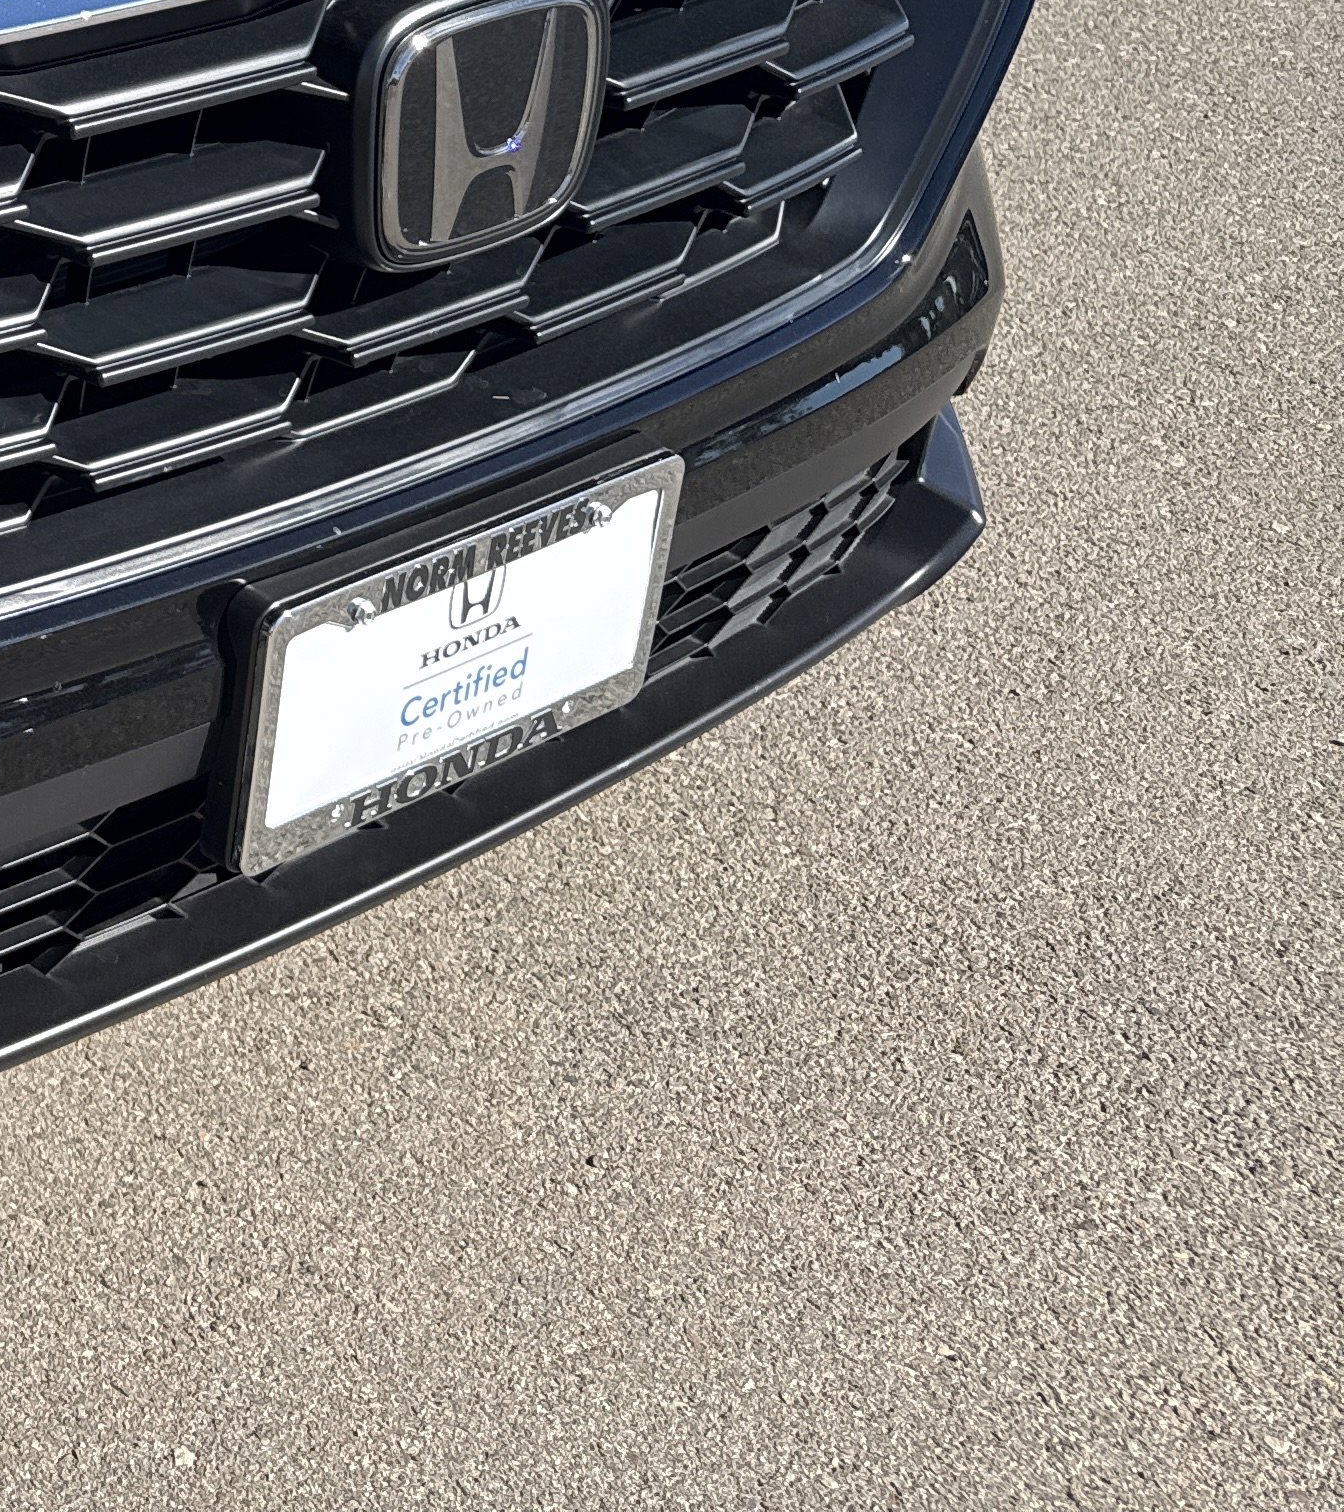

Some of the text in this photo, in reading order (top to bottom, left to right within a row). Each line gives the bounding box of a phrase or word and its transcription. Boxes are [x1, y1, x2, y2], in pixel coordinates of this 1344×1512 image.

[380, 498, 590, 613] NORM REEVES
[419, 616, 521, 670] HONDA
[397, 681, 524, 752] Pre-Owned
[400, 646, 529, 727] Certified
[346, 708, 561, 828] HONDA
